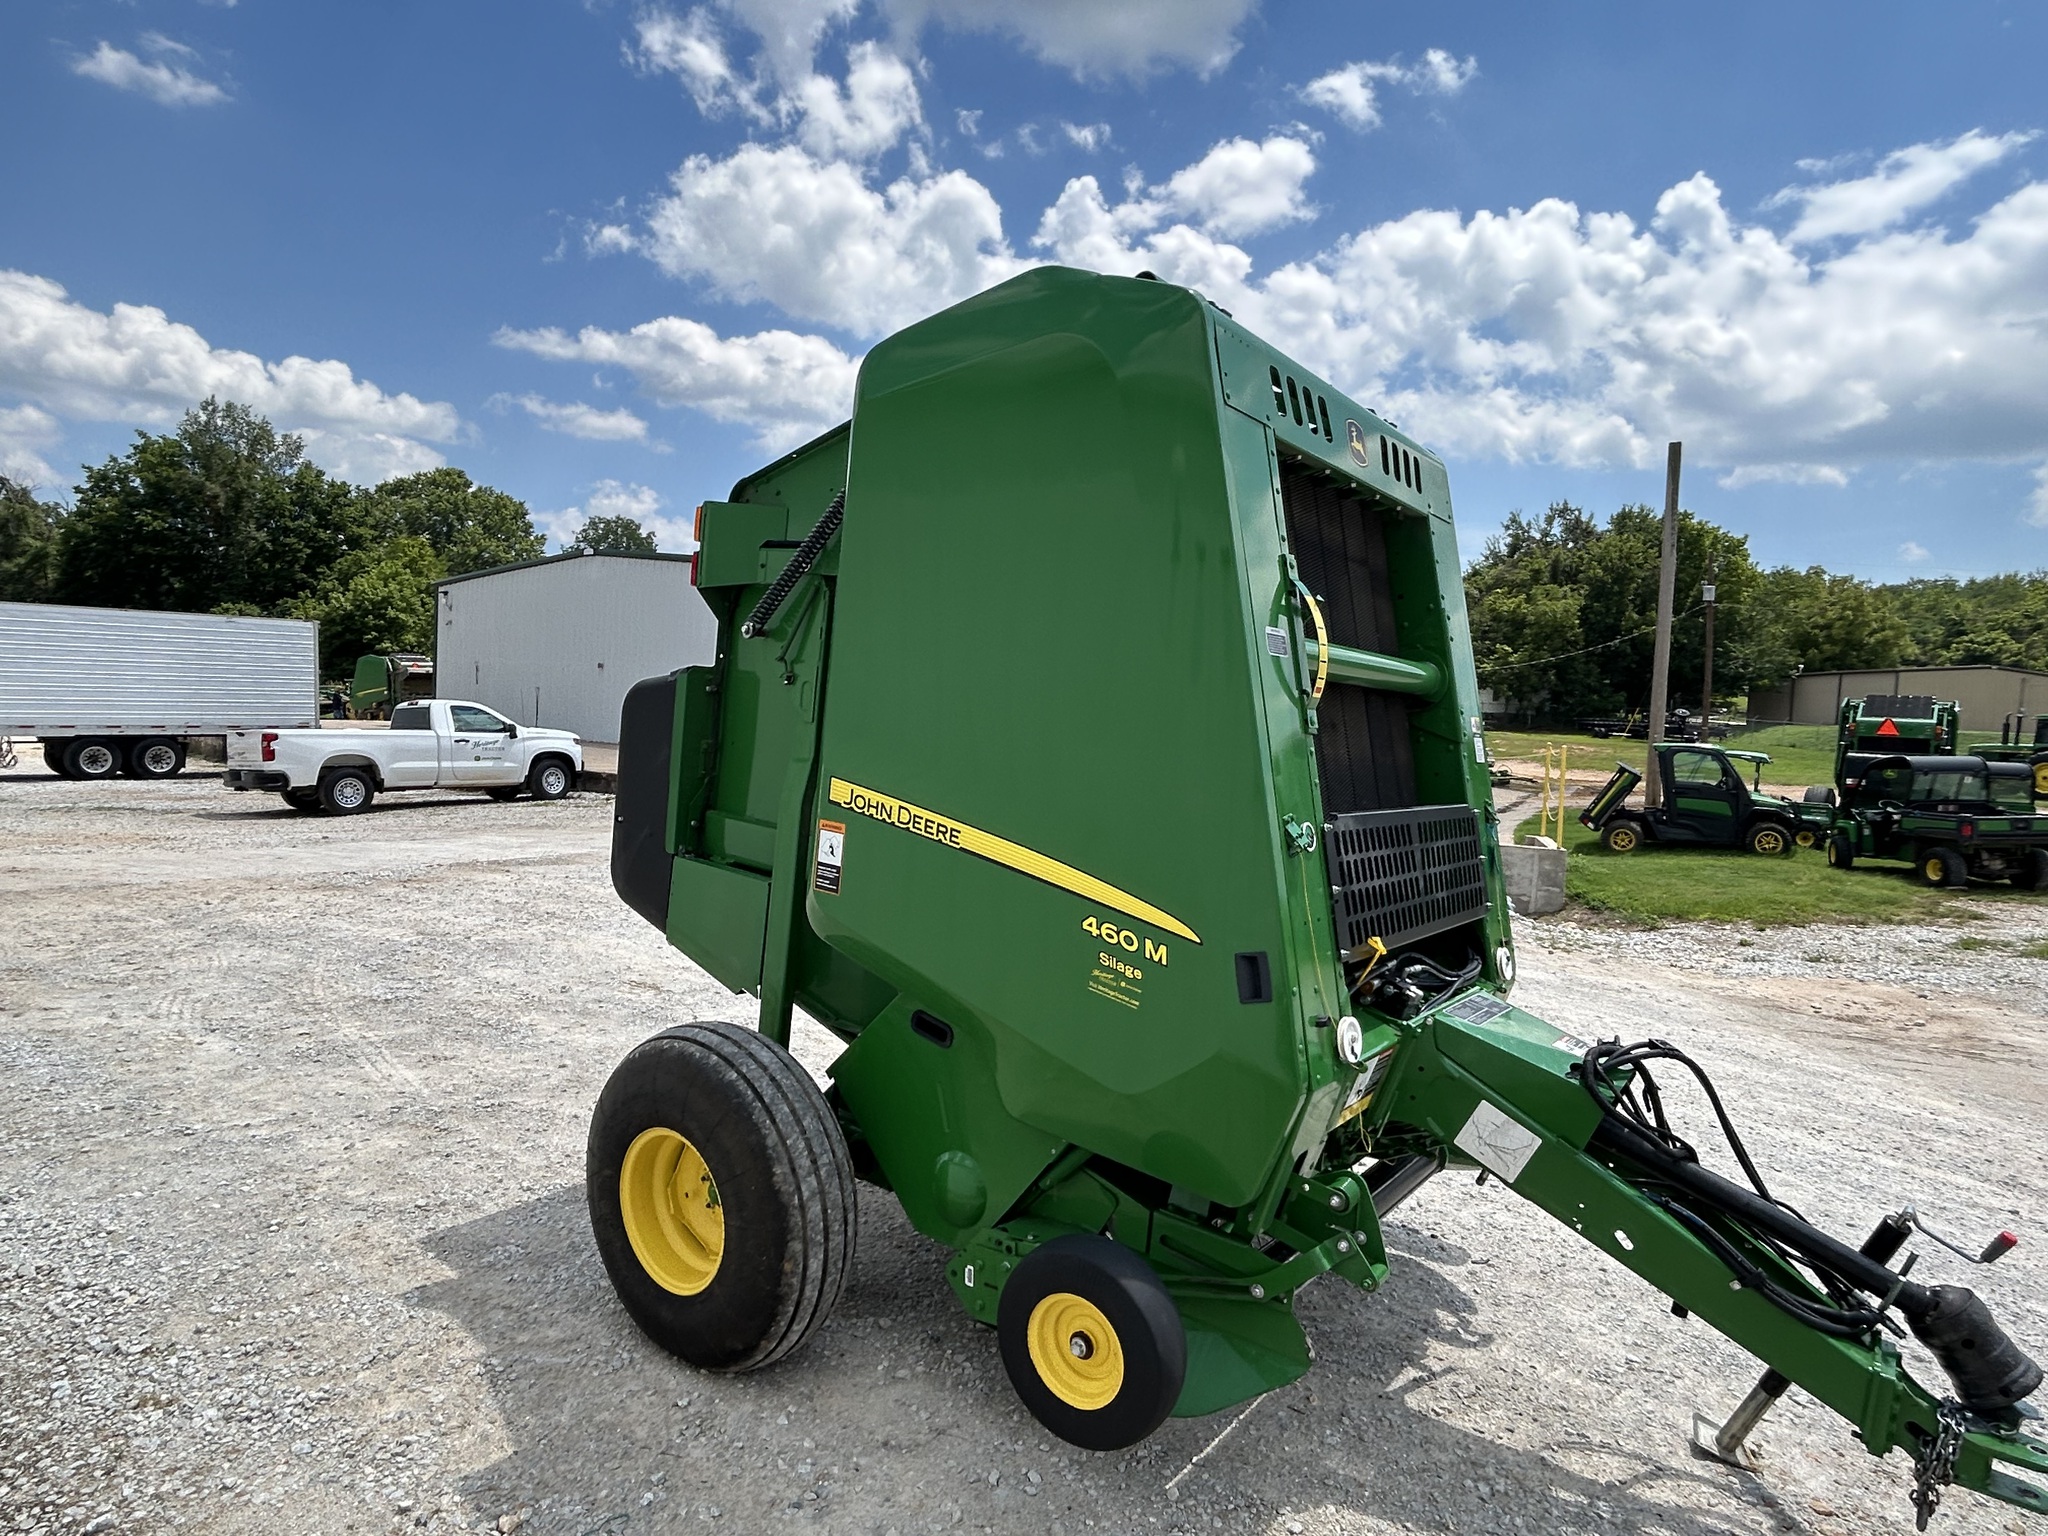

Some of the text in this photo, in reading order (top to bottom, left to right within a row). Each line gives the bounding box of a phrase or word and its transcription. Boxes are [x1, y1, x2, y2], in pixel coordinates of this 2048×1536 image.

[843, 788, 962, 846] JOHN DEERE
[1081, 915, 1168, 967] 460 M
[1098, 951, 1142, 980] Silage
